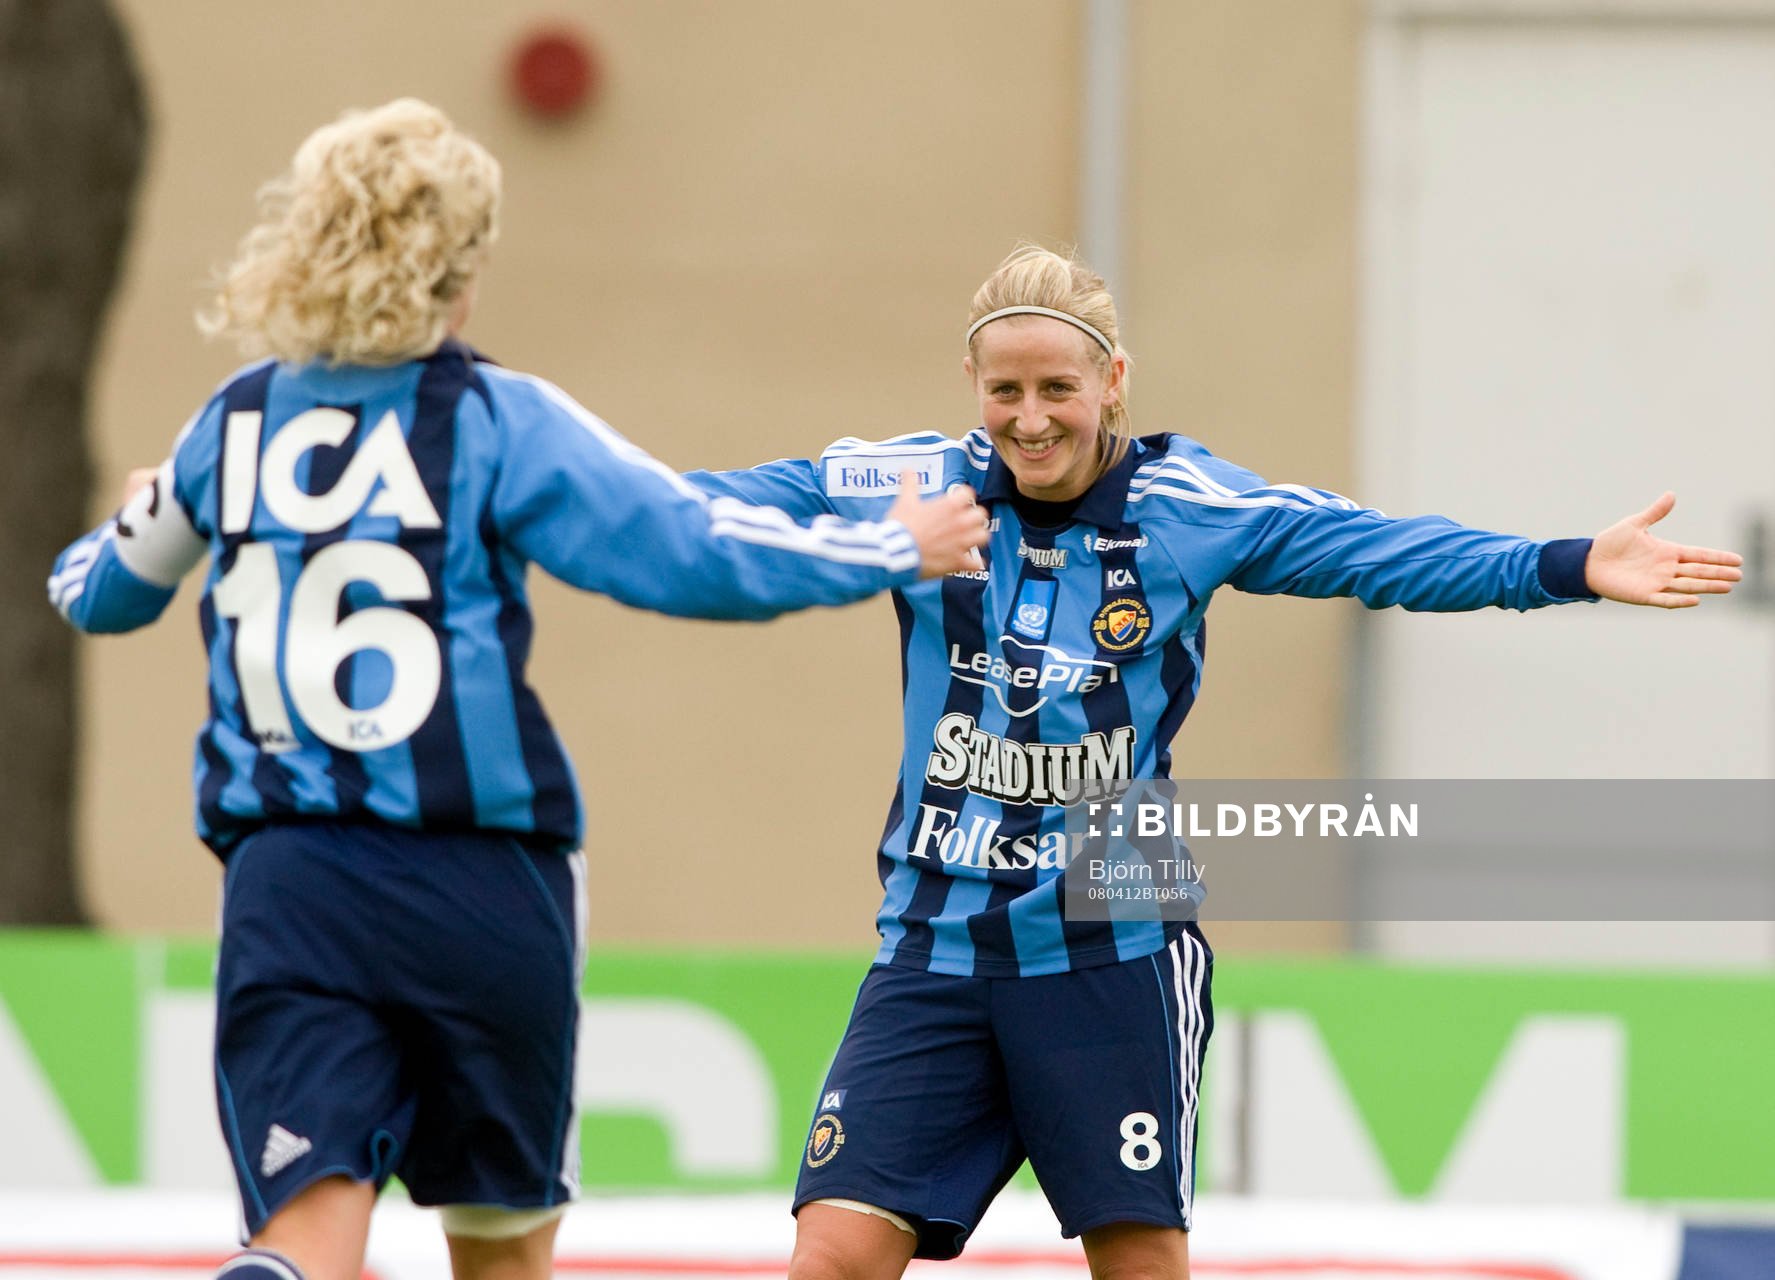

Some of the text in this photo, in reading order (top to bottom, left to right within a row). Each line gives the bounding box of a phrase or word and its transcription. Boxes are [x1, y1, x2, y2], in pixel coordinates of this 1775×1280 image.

[221, 407, 443, 535] ICA
[1107, 568, 1137, 588] ICA
[212, 539, 442, 753] 16
[348, 720, 383, 739] ICA
[927, 713, 1136, 805] STADIUM
[1119, 1111, 1162, 1171] 8
